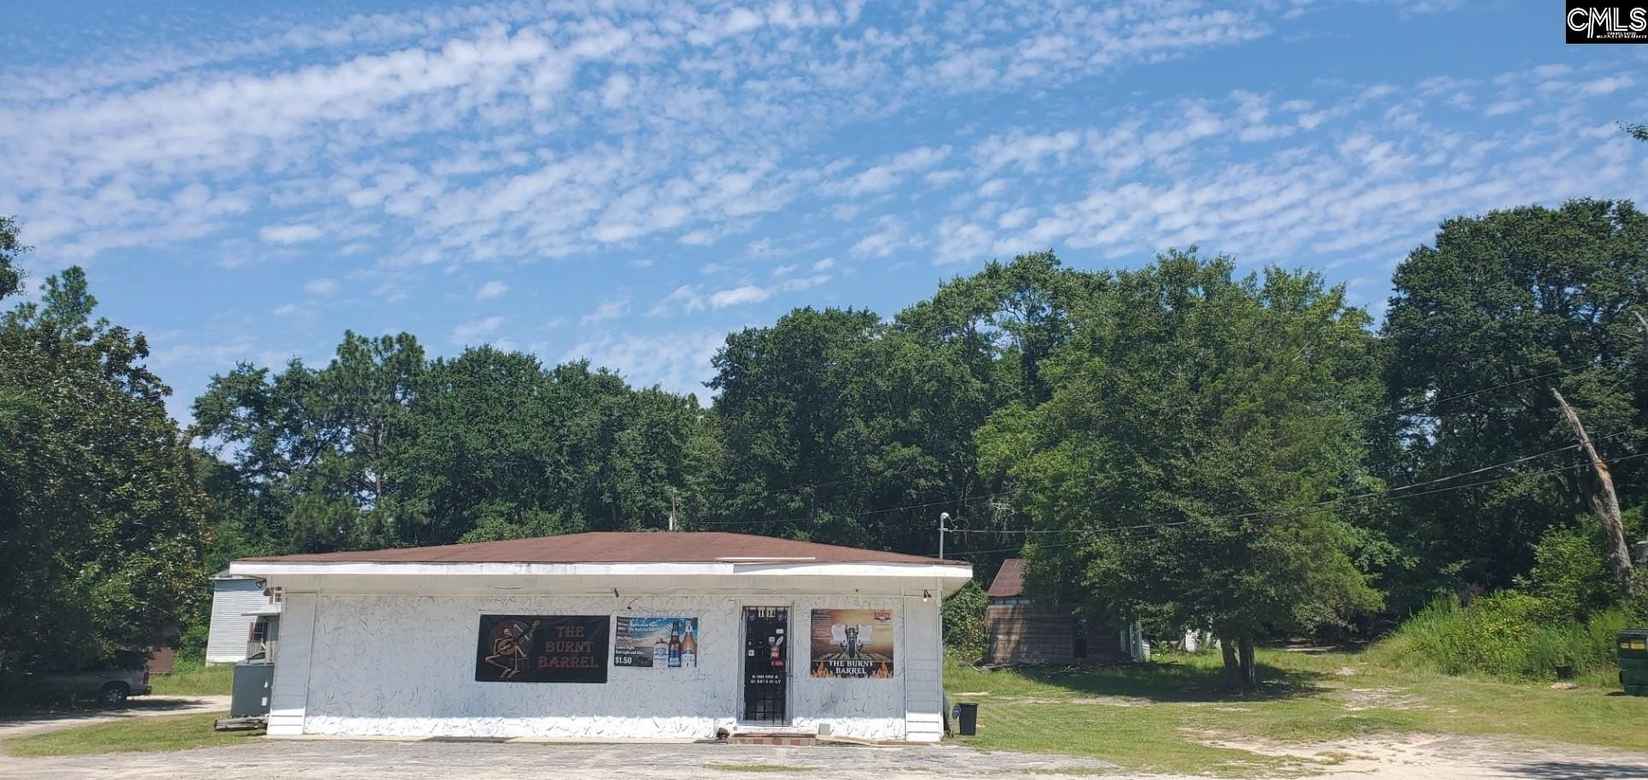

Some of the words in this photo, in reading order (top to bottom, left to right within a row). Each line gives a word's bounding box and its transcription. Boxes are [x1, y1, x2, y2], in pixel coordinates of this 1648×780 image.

[554, 625, 584, 638] THE
[544, 640, 593, 653] BURNT
[536, 655, 600, 669] BARREL
[614, 656, 633, 665] $1.50
[829, 659, 845, 667] THE
[847, 659, 873, 667] BURNT
